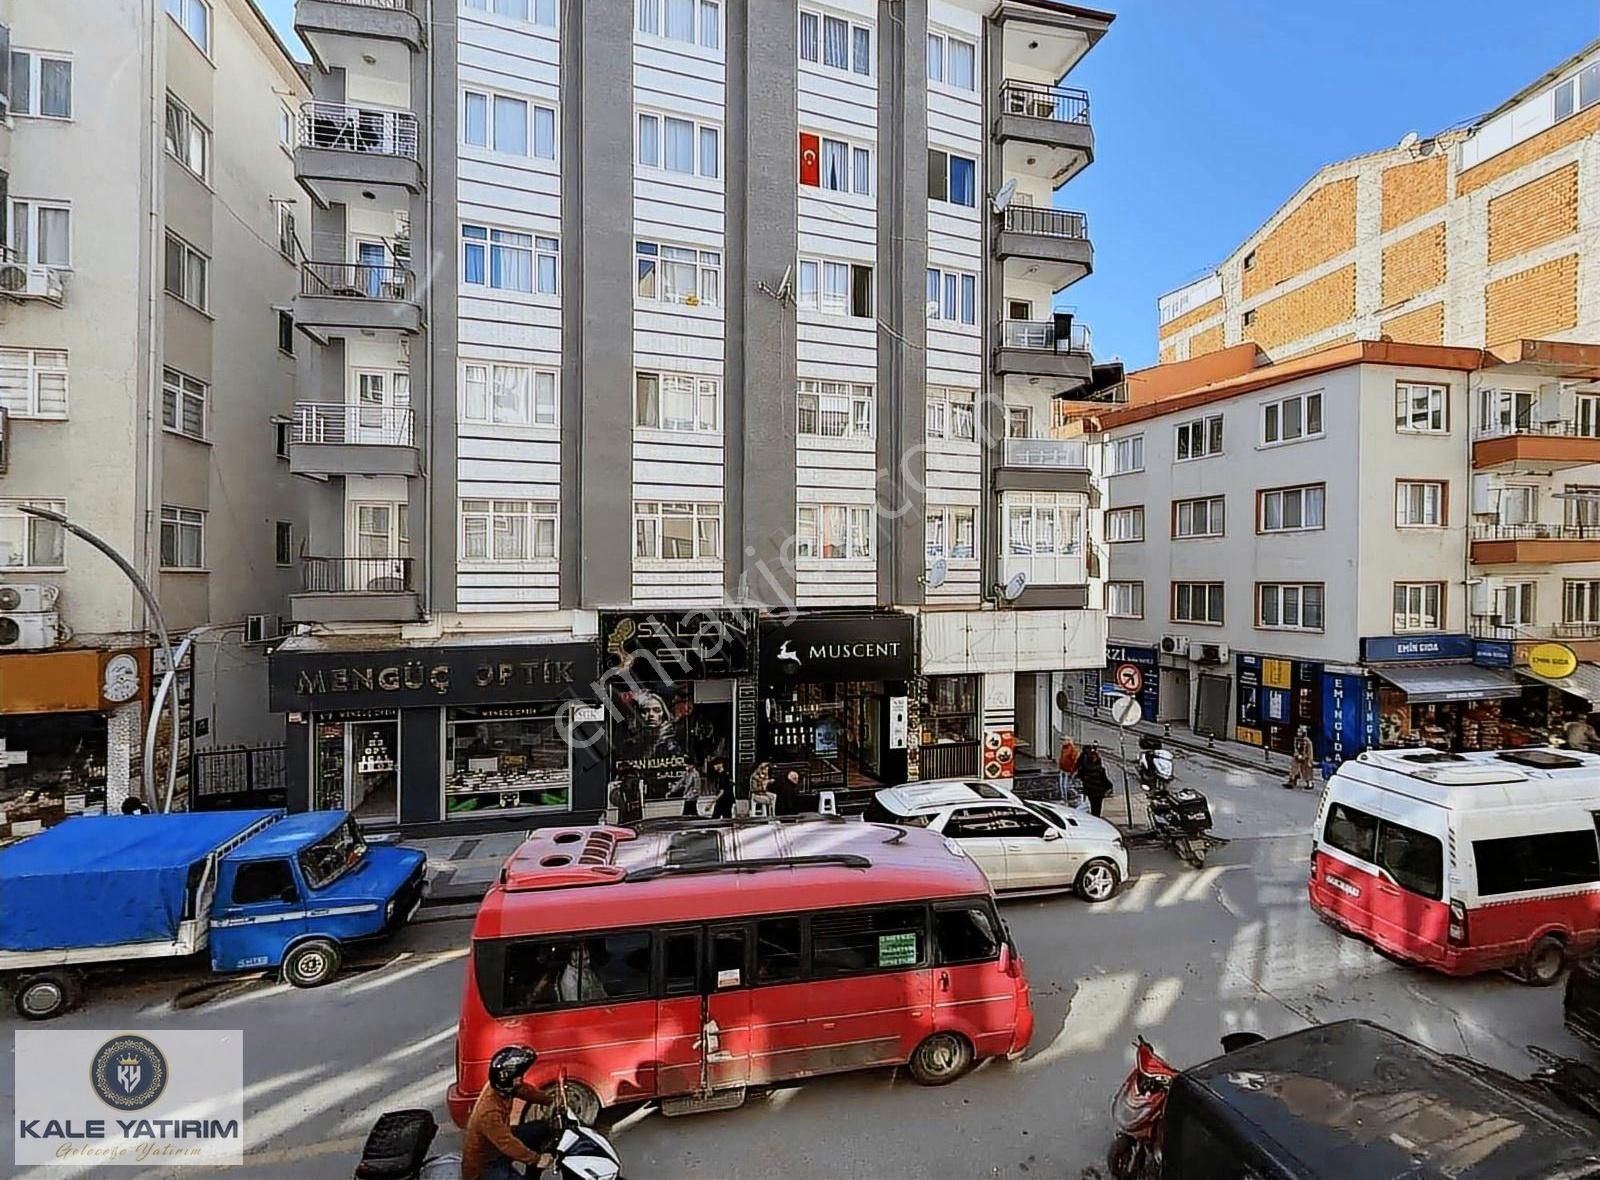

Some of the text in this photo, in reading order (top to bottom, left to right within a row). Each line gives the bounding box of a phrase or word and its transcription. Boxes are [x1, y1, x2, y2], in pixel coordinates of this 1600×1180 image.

[637, 620, 747, 638] SALON
[808, 642, 901, 660] MUSCENT
[296, 658, 574, 695] MENGÜÇ OPTİK
